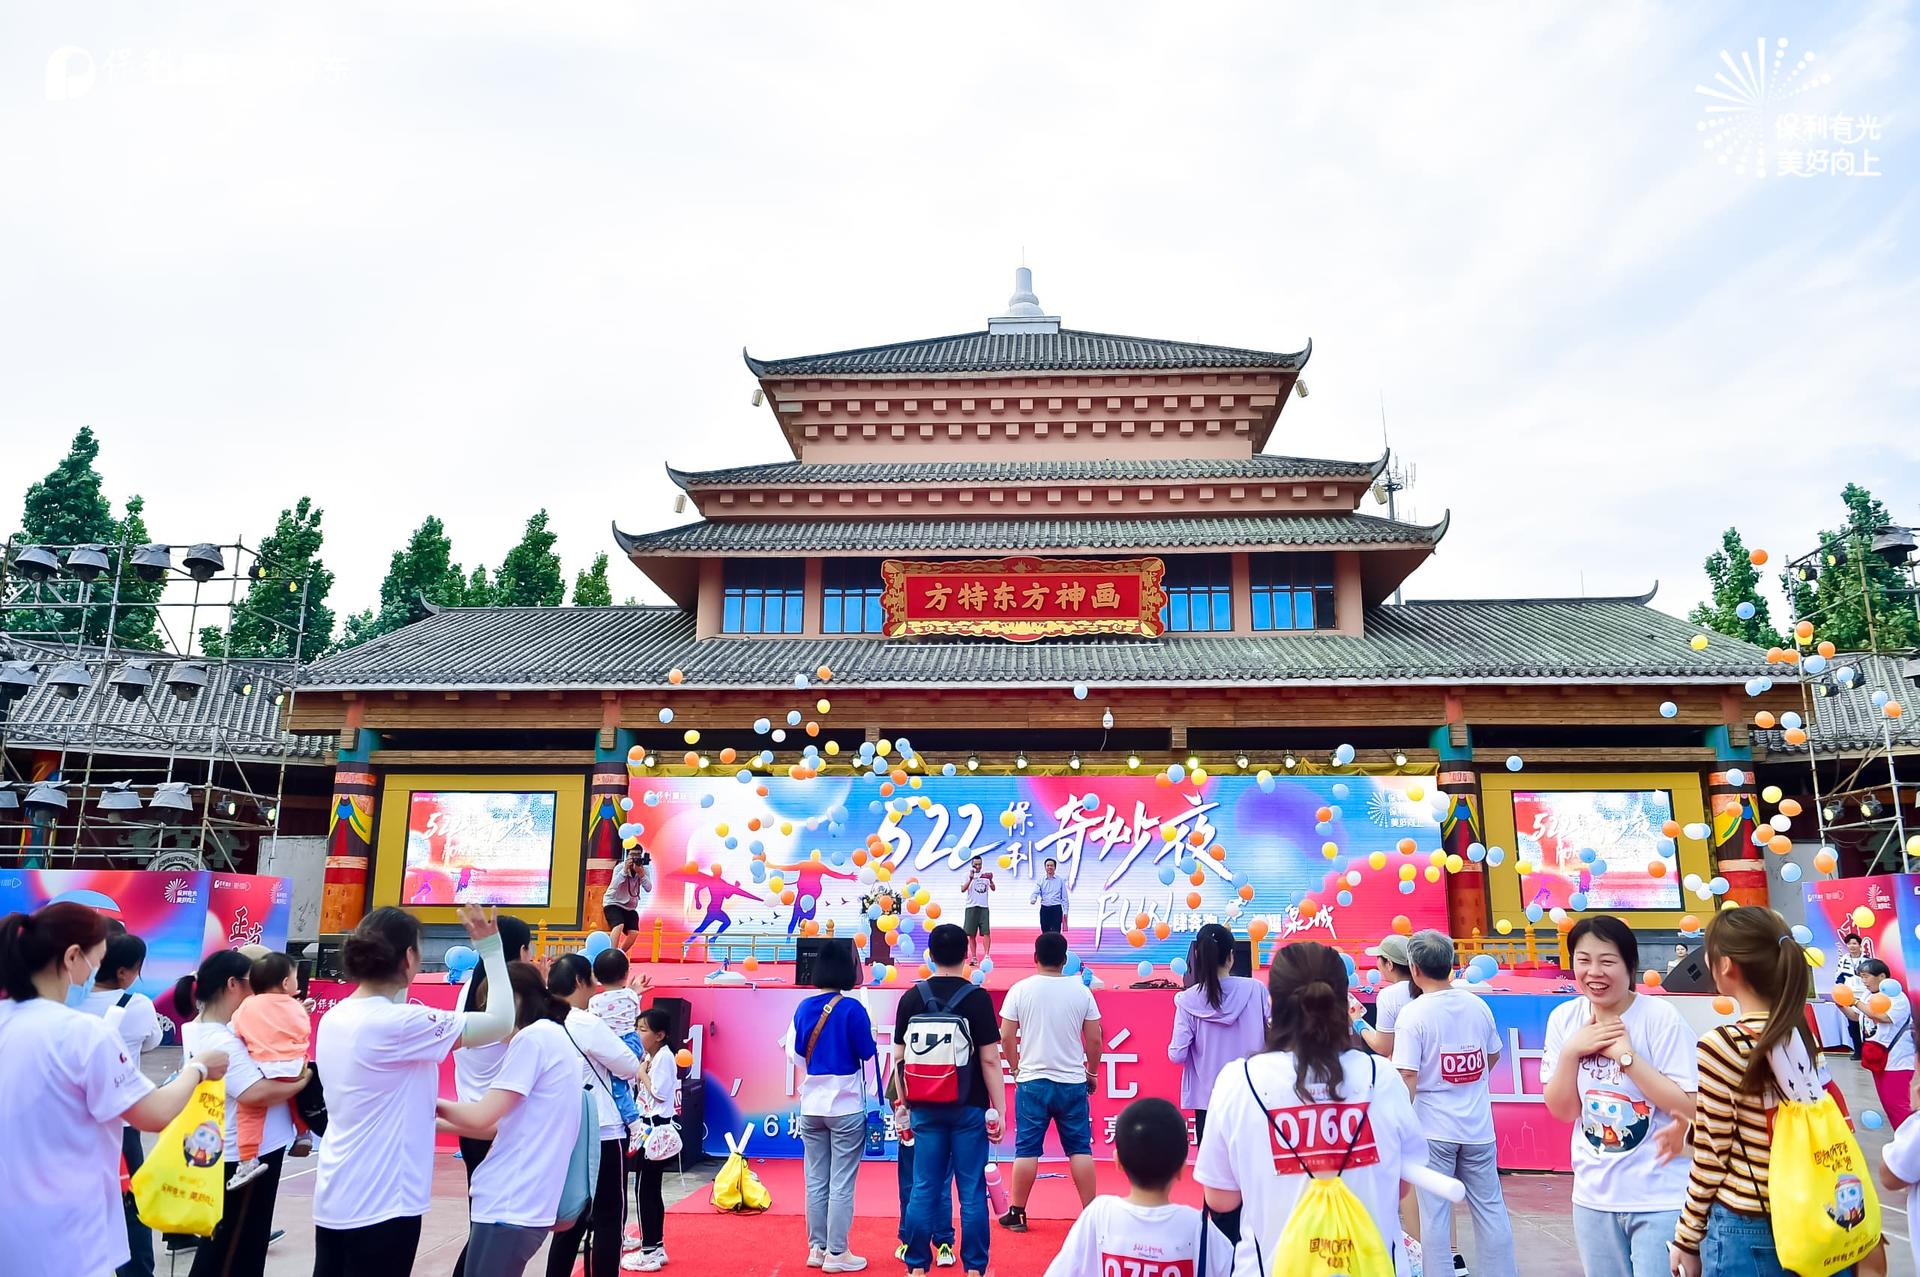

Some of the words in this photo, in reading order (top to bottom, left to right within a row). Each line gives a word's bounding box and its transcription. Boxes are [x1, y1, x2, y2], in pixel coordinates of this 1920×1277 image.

[924, 581, 1121, 611] 方特东方神画
[868, 795, 1006, 872] 522
[1034, 791, 1238, 891] 奇妙夜
[1443, 1051, 1482, 1073] 0208
[1274, 1107, 1364, 1149] 0760
